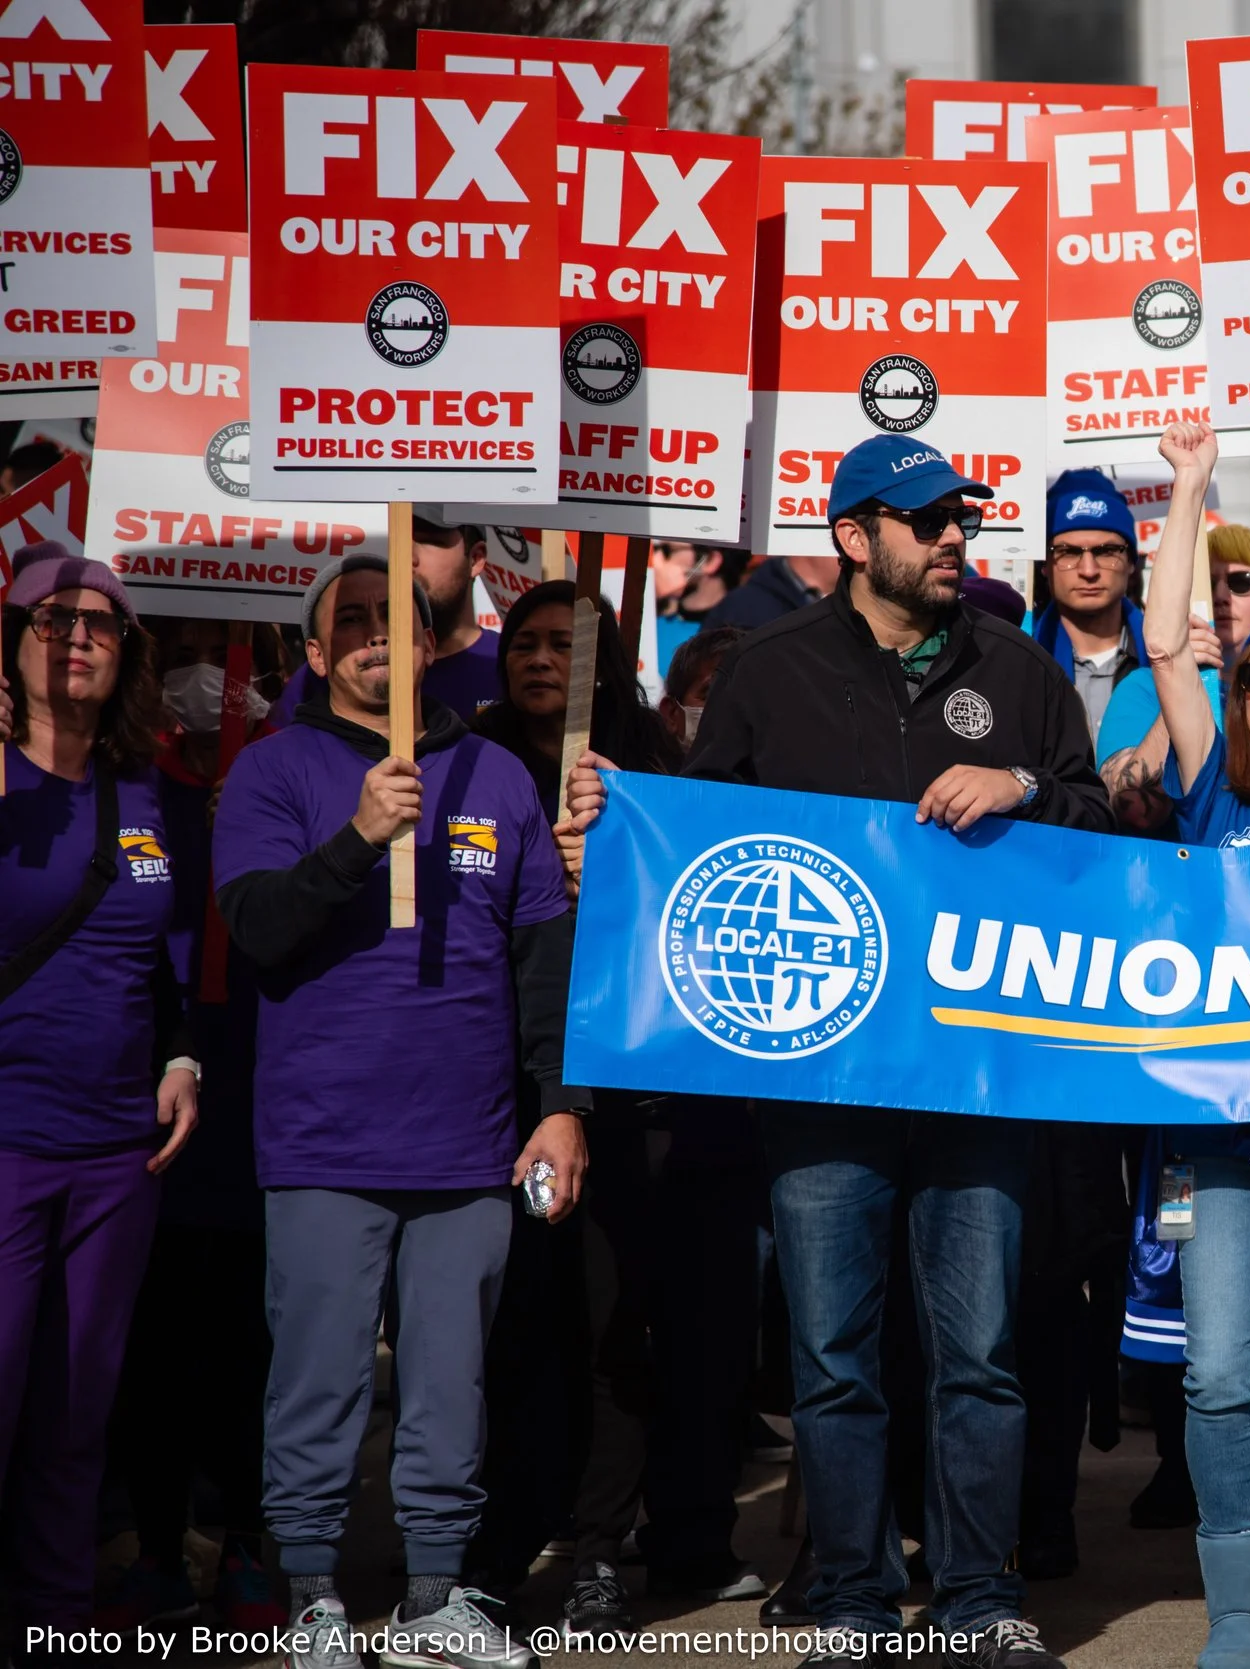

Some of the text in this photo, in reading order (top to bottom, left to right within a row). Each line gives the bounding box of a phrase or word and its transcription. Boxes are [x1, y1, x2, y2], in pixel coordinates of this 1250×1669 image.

[0, 62, 112, 101] ITY
[283, 92, 530, 202] FIX
[151, 160, 216, 193] TY
[0, 231, 132, 255] RVICES
[280, 217, 530, 260] OUR CITY
[784, 181, 1020, 281] FIX
[1056, 229, 1156, 265] OUR
[371, 286, 443, 321] SAN FRANCISCO
[607, 267, 726, 309] CITY
[1136, 283, 1199, 313] SAN FRANCISCO
[4, 309, 136, 334] GREED
[780, 296, 1019, 334] OUR CITY
[372, 332, 443, 363] CITY WORKERS
[567, 327, 637, 363] SAN FRANCISCO
[1138, 318, 1199, 347] CITY WORKERS
[129, 360, 241, 398] OUR
[567, 369, 635, 401] CITY WORKERS
[864, 358, 934, 391] SAN FRANCISCO
[1064, 364, 1207, 402] STAFF
[279, 387, 534, 427] PROTECT
[866, 400, 933, 430] CITY WORKERS
[1066, 411, 1121, 434] SAN
[210, 432, 229, 454] SAN
[277, 437, 535, 462] PUBLIC SERVICES
[649, 428, 719, 464] UP
[210, 465, 230, 486] CITY
[891, 451, 945, 473] LOCAL
[951, 454, 1022, 487] UP
[559, 469, 715, 499] RANCISCO
[1121, 483, 1175, 507] GRE
[113, 508, 365, 557] STAFF UP
[111, 554, 316, 586] SAN FRANCIS
[448, 816, 497, 827] LOCAL 1021
[131, 859, 169, 877] SEIU
[449, 849, 497, 868] SEIU
[450, 866, 496, 876] Stronger Together
[670, 844, 878, 993] PROFESSIONAL & TECHNICAL ENGINEERS
[695, 925, 852, 964] LOCAL 21
[697, 1004, 852, 1049] IFPTE AFL-CIO
